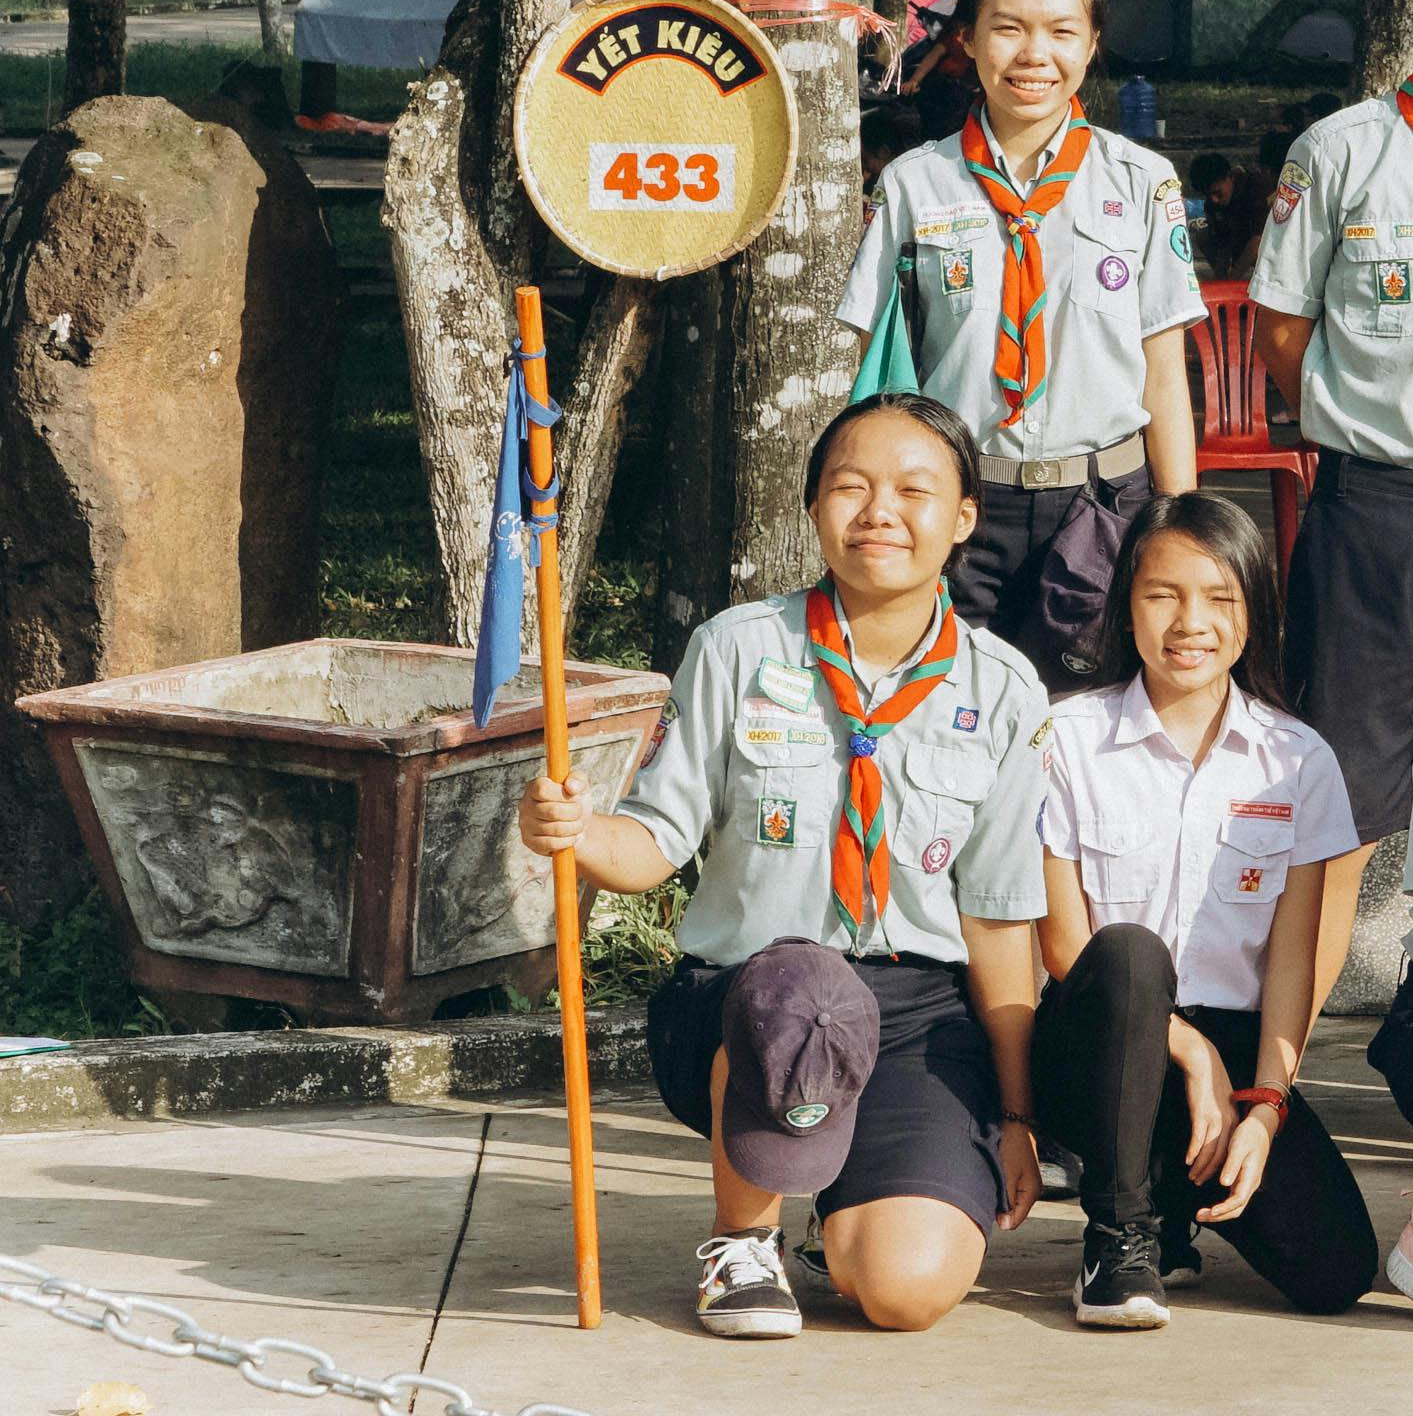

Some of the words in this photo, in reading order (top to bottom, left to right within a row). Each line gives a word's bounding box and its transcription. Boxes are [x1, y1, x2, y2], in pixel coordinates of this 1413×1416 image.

[575, 24, 642, 81] YẾT
[657, 20, 746, 82] KIÊU
[603, 152, 720, 202] 433
